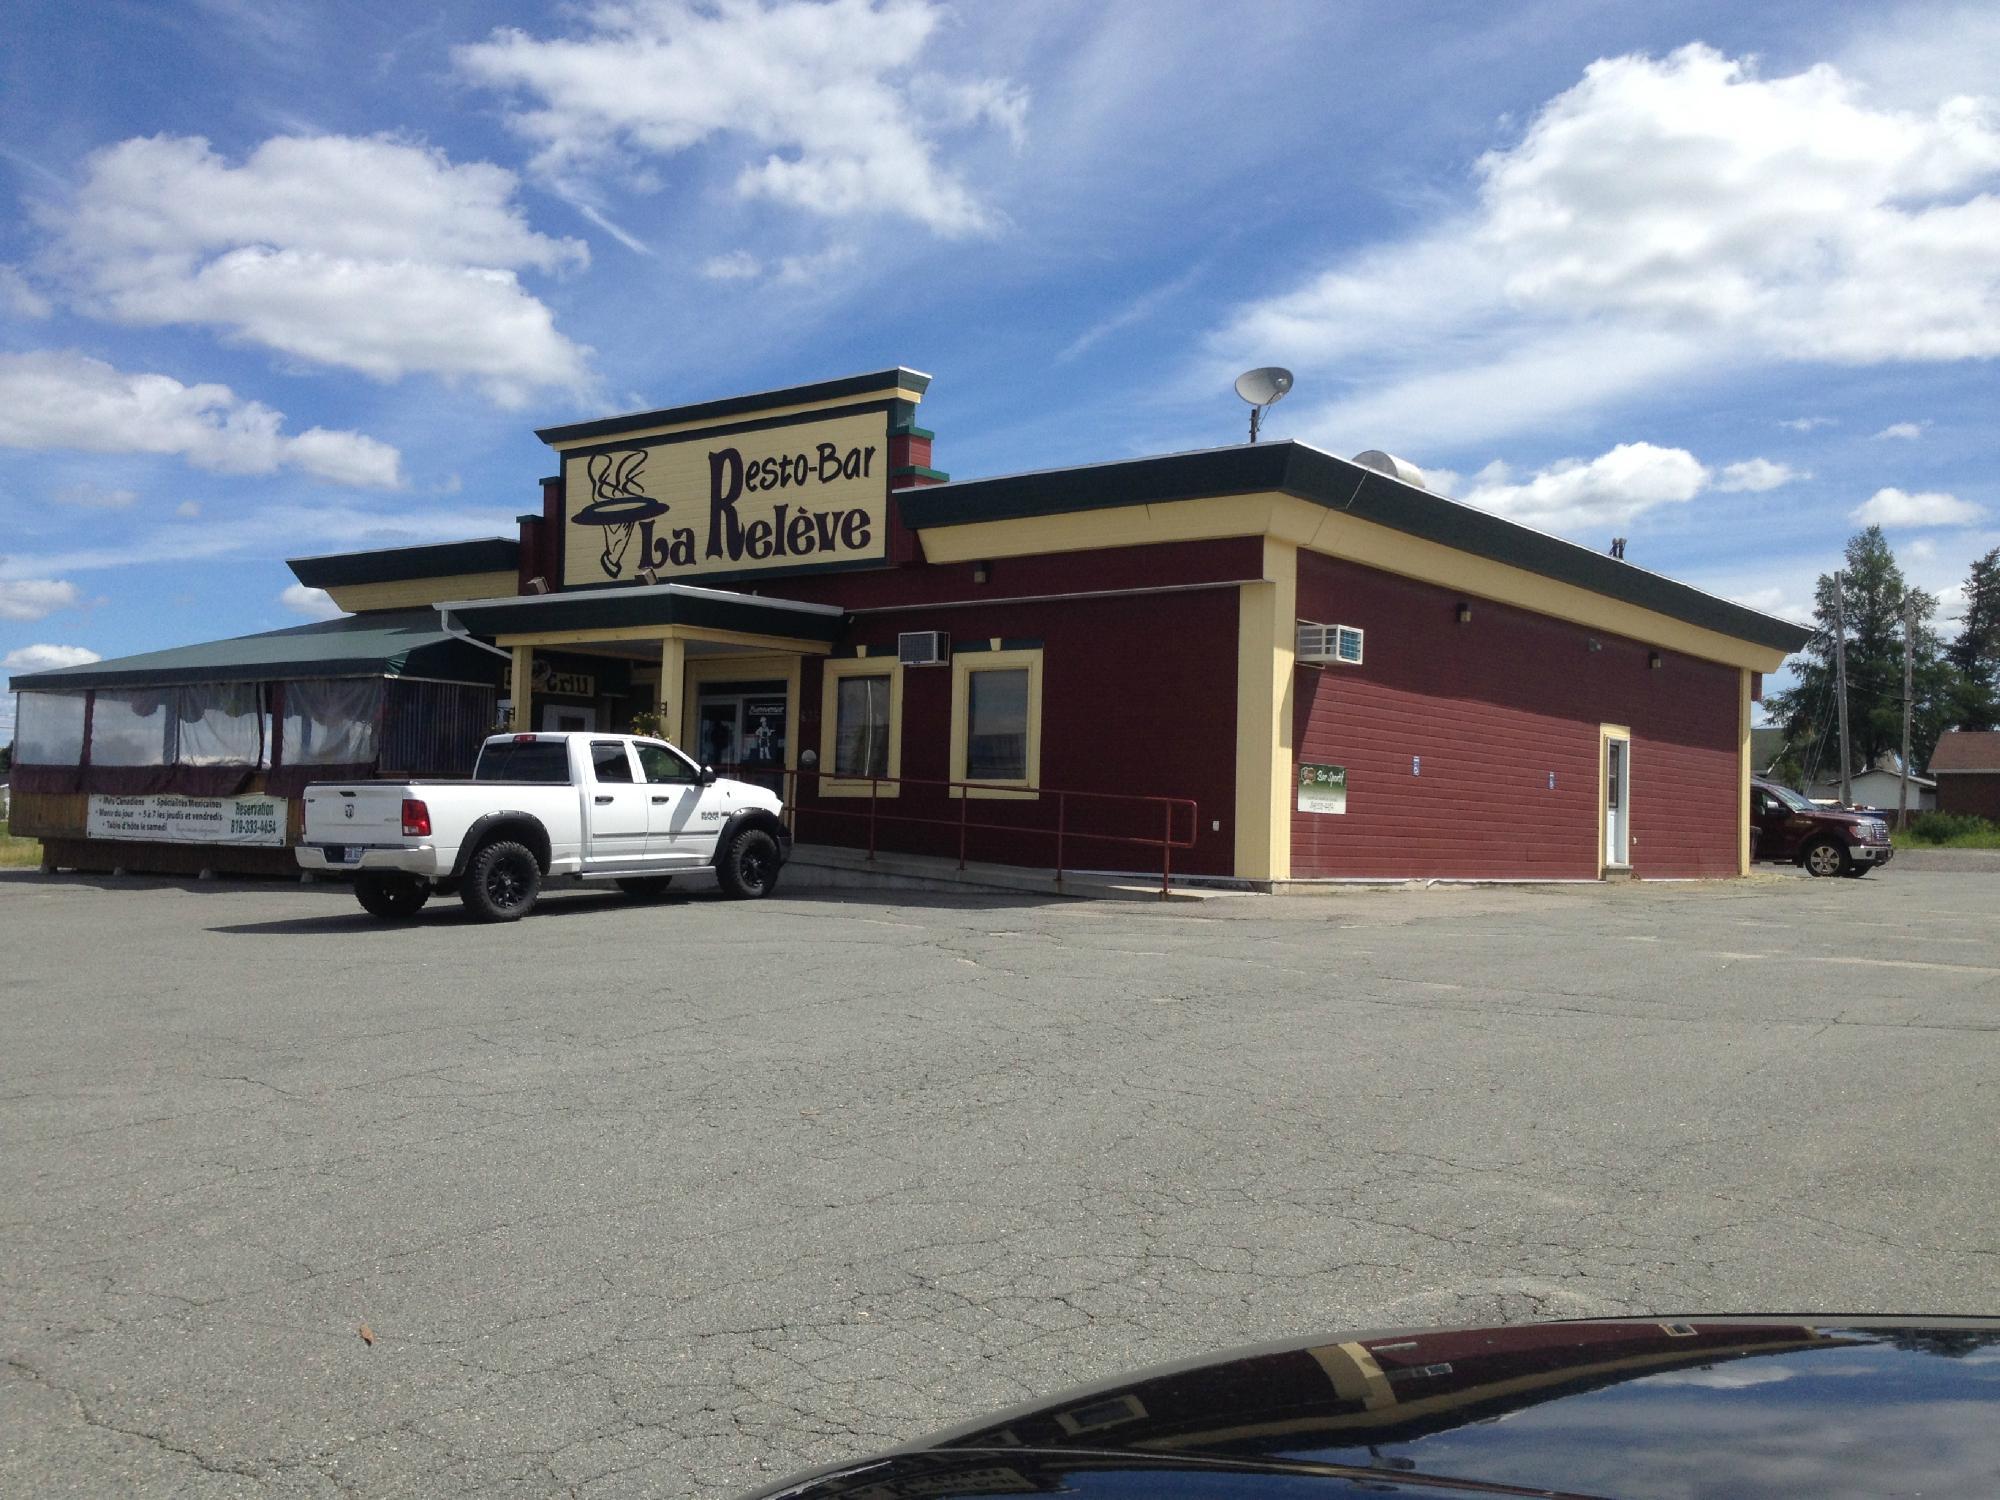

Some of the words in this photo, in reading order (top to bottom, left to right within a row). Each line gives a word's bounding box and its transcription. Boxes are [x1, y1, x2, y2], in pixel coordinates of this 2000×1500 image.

[708, 442, 876, 508] Resto-Bar
[638, 519, 697, 569] La
[705, 500, 871, 561] Relève
[122, 809, 134, 819] jour
[165, 810, 184, 821] jeudis
[184, 812, 191, 820] et
[192, 811, 223, 821] vendredis
[146, 822, 168, 832] samedi
